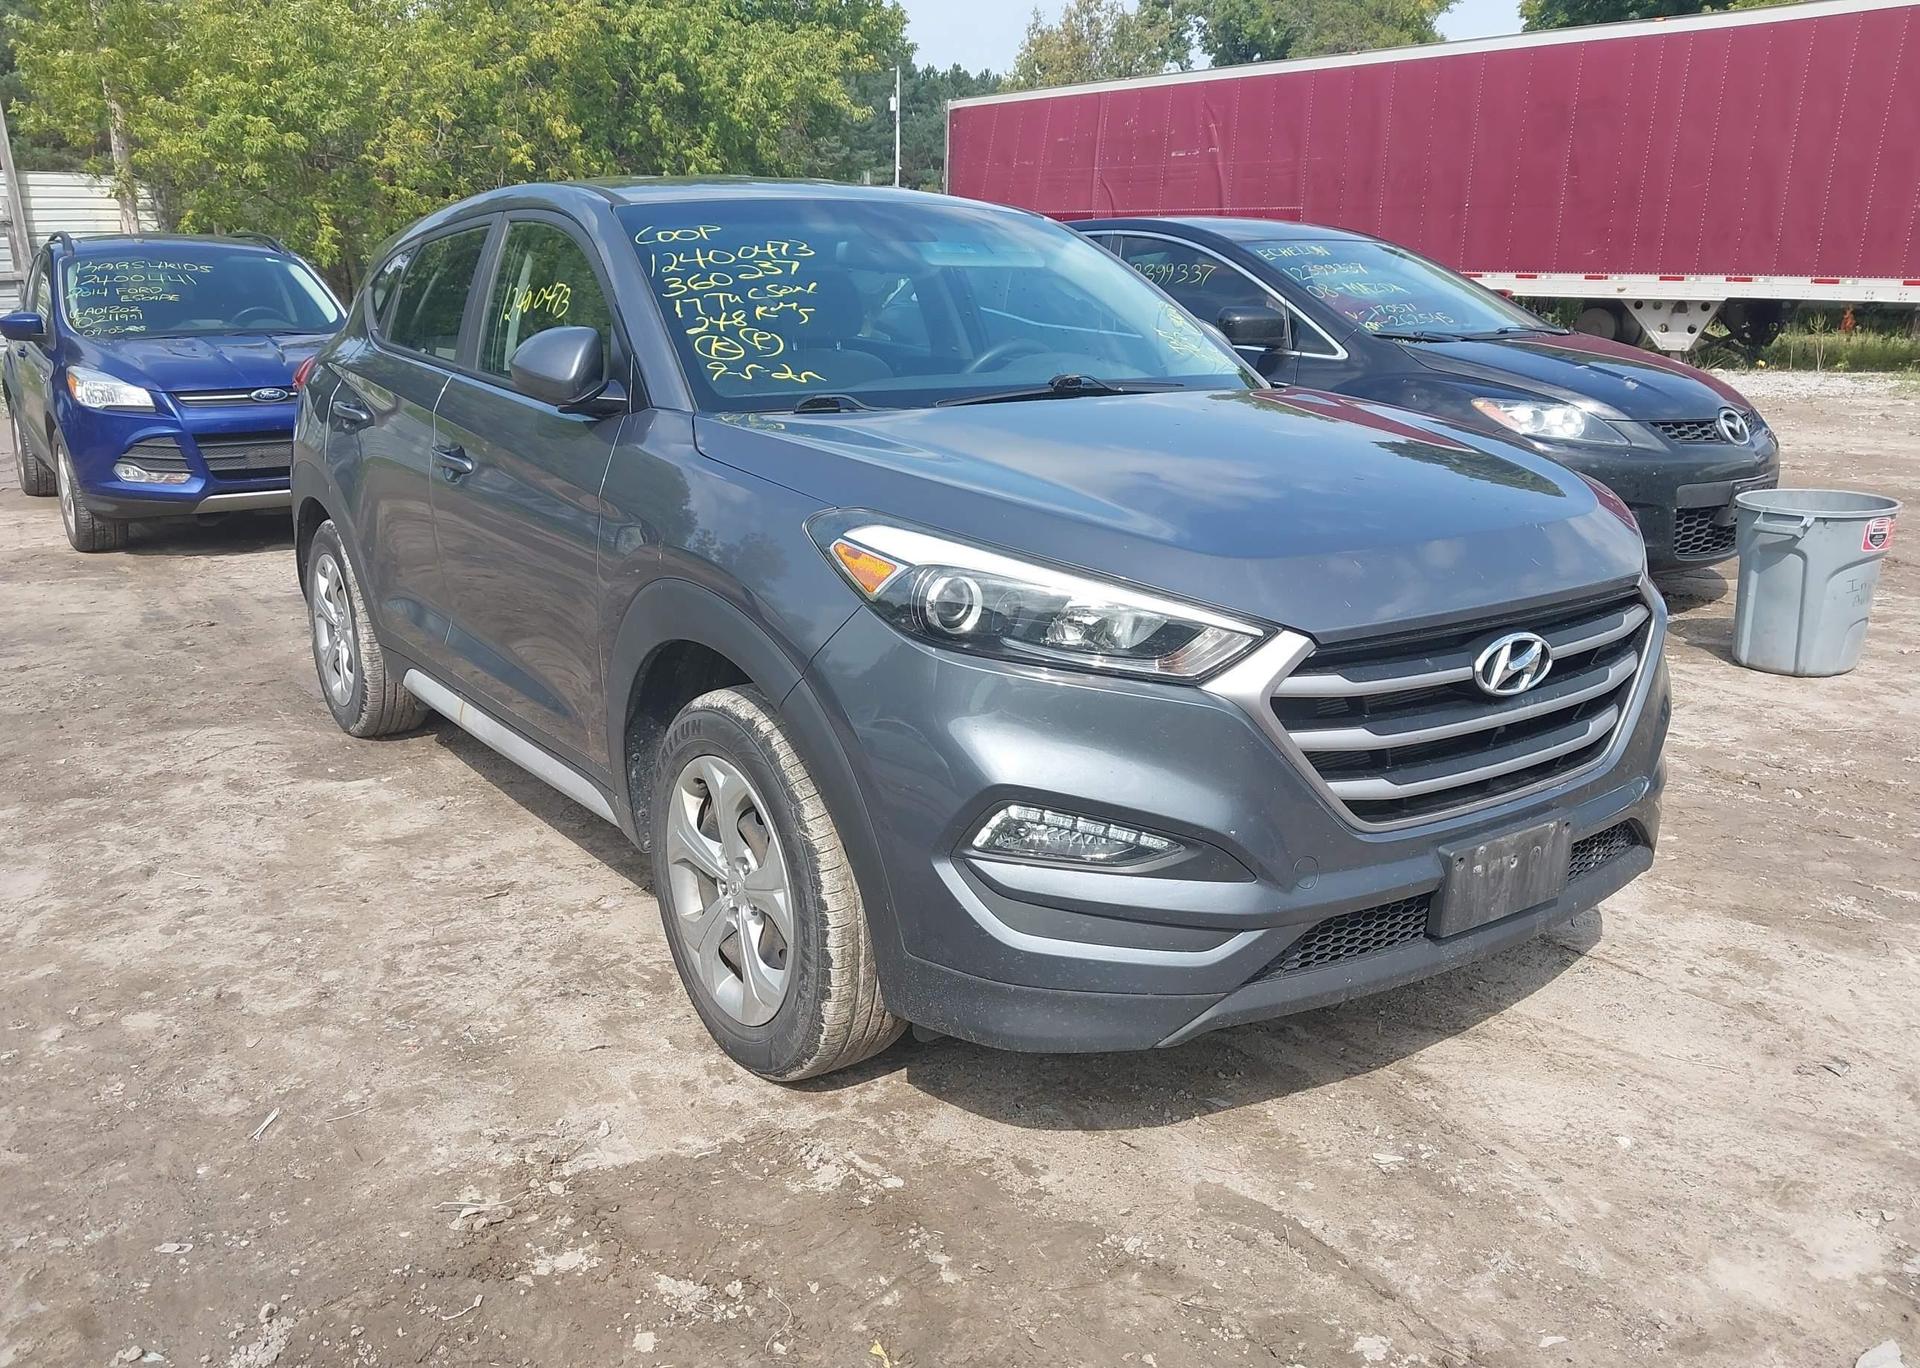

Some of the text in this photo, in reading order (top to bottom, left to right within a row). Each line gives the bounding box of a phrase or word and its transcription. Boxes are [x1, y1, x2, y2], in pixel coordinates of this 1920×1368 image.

[635, 225, 722, 244] COOP
[71, 273, 197, 286] 12400441
[116, 286, 163, 296] FORD
[686, 309, 747, 334] 248
